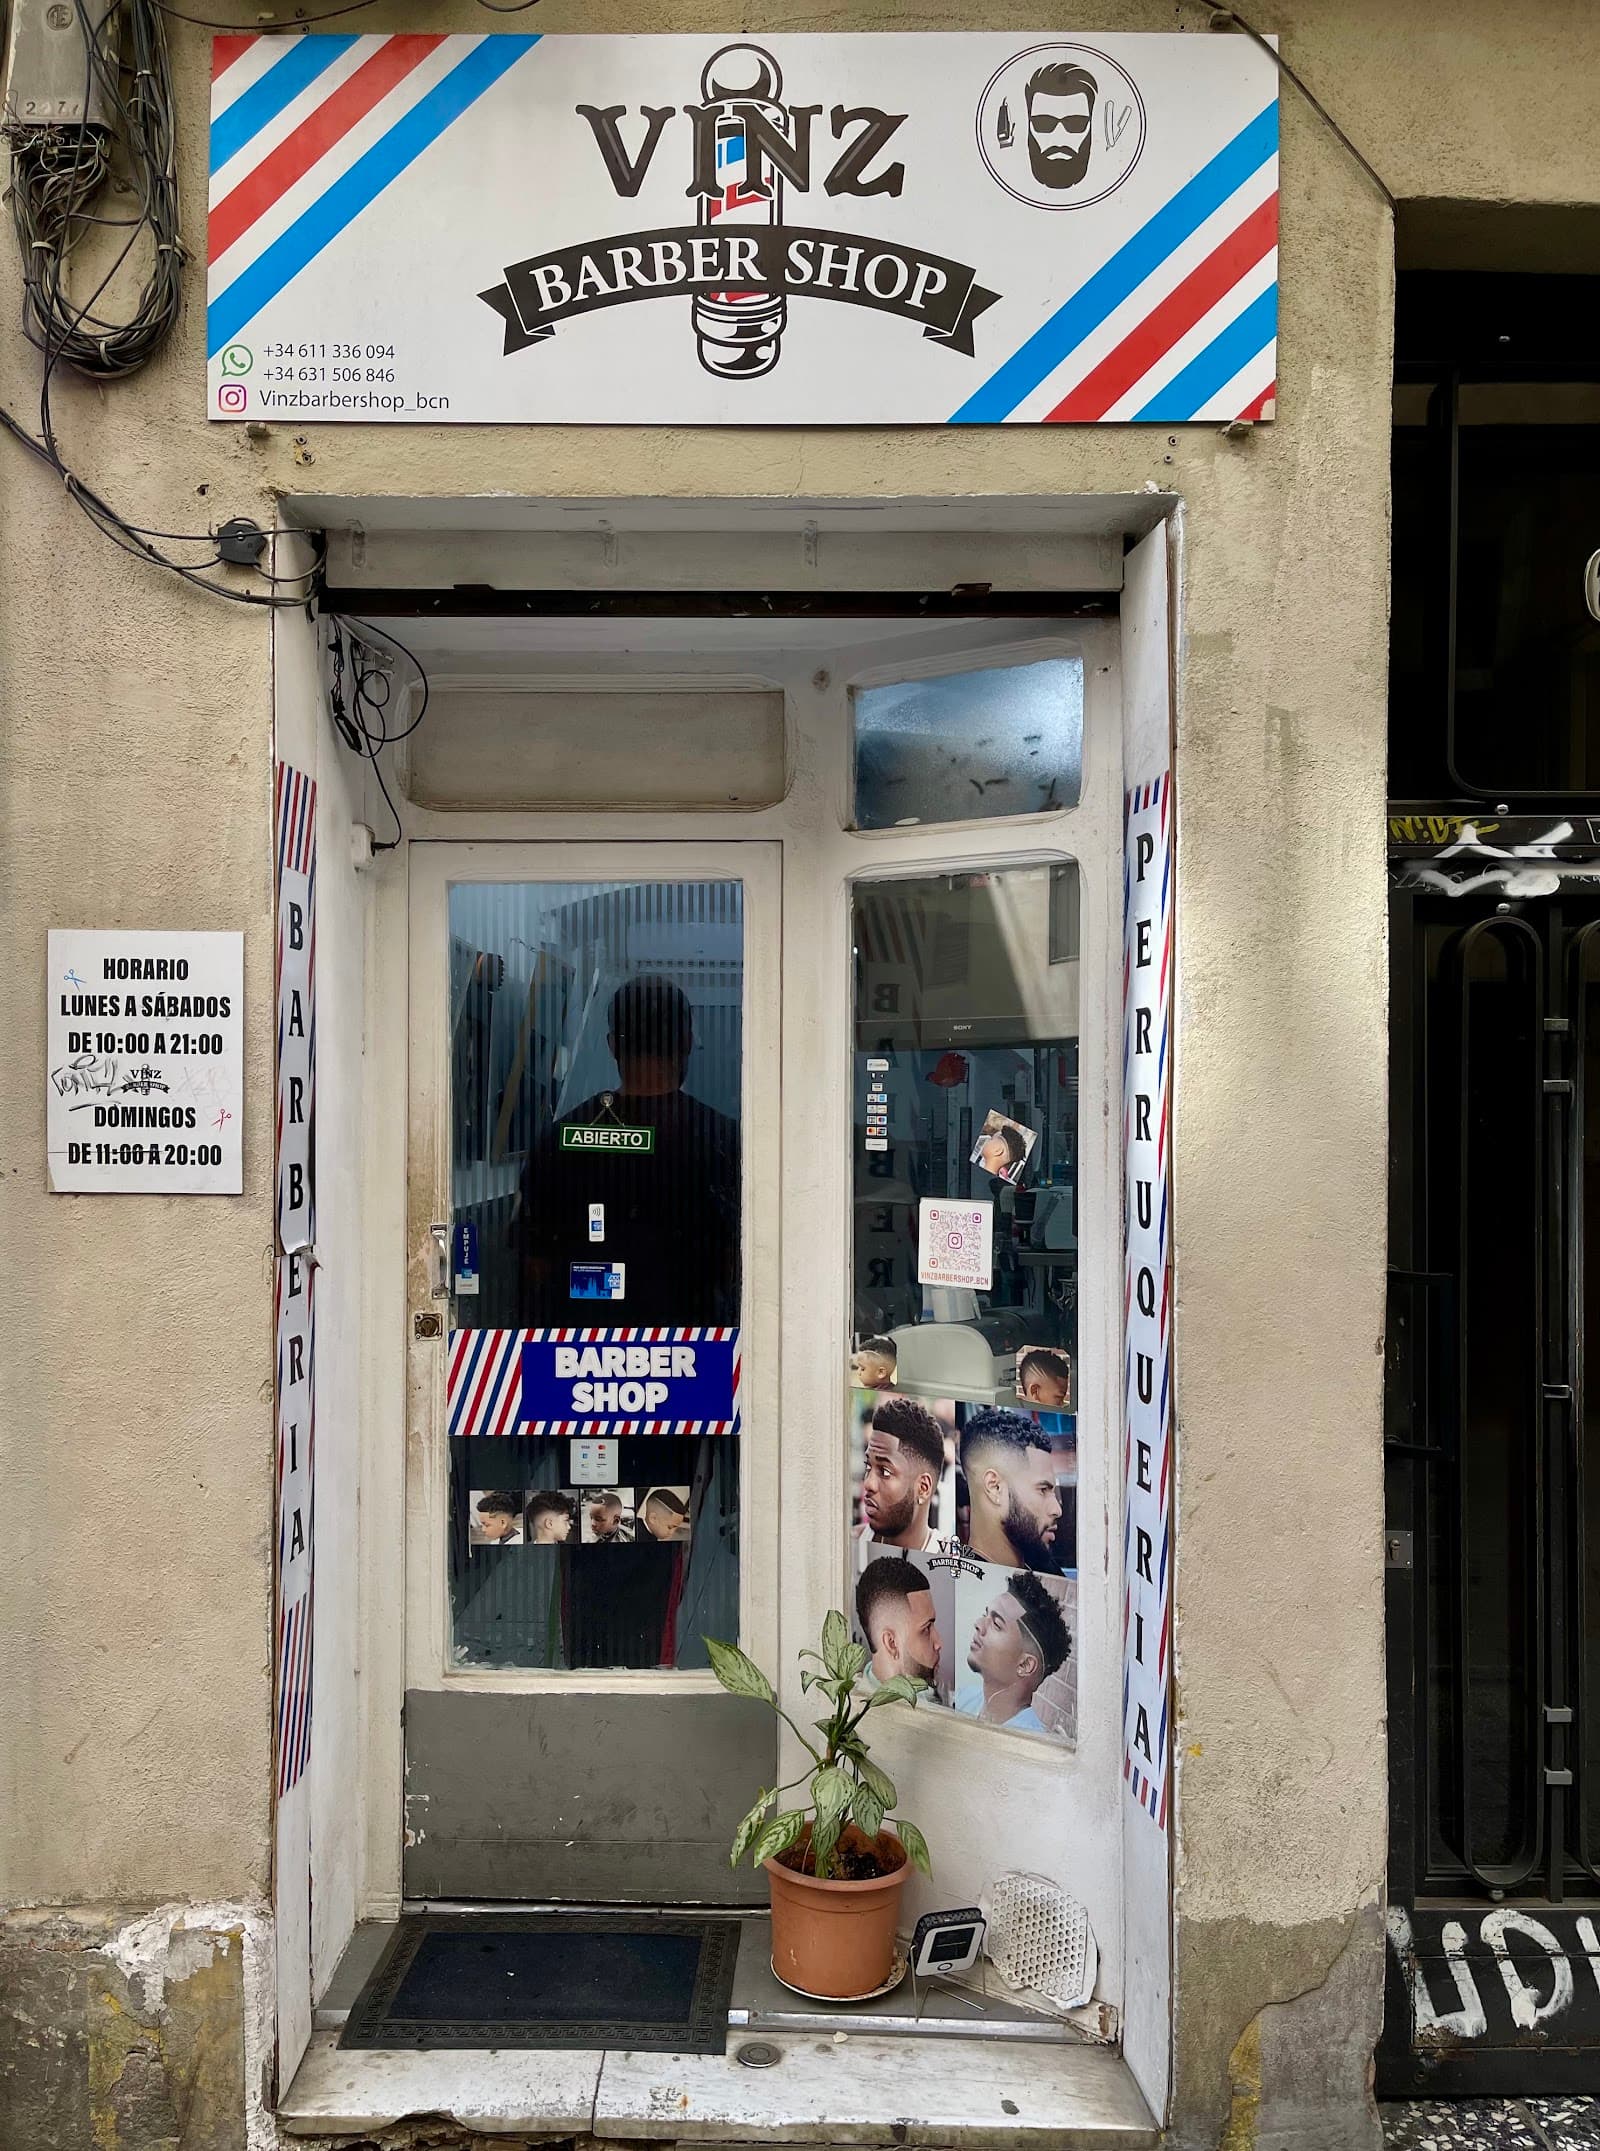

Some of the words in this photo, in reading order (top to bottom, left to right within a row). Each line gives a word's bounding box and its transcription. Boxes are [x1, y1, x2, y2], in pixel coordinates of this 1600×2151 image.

[575, 104, 908, 198] VINZ
[530, 236, 767, 312] BARBER
[784, 238, 948, 310] SHOP
[263, 343, 295, 358] +34
[299, 344, 326, 358] 611
[332, 344, 361, 359] 336
[366, 345, 395, 359] 094
[263, 367, 294, 381] +34
[299, 367, 326, 381] 631
[332, 368, 361, 382] 506
[366, 368, 395, 383] 846
[259, 390, 450, 412] Vinzbarbershop_bcn
[103, 958, 189, 981] HORARIO
[61, 995, 120, 1017] LUNES
[125, 995, 137, 1017] A
[142, 991, 231, 1018] SÁBADOS
[68, 1032, 92, 1054] DE
[96, 1032, 149, 1054] 10:00
[153, 1033, 166, 1055] A
[170, 1033, 223, 1055] 21:00
[94, 1106, 196, 1128] DOMINGOS
[570, 1129, 643, 1147] ABIERTO
[68, 1142, 92, 1165] DE
[96, 1143, 144, 1165] 11:00
[148, 1143, 161, 1165] A
[164, 1144, 222, 1166] 20:00
[287, 900, 305, 1562] BARBERIA
[920, 1271, 989, 1286] VINZBARBERSHOP_BCN
[1134, 832, 1155, 1765] PERRUQUERIA
[555, 1346, 697, 1379] BARBER
[570, 1382, 669, 1414] SHOP
